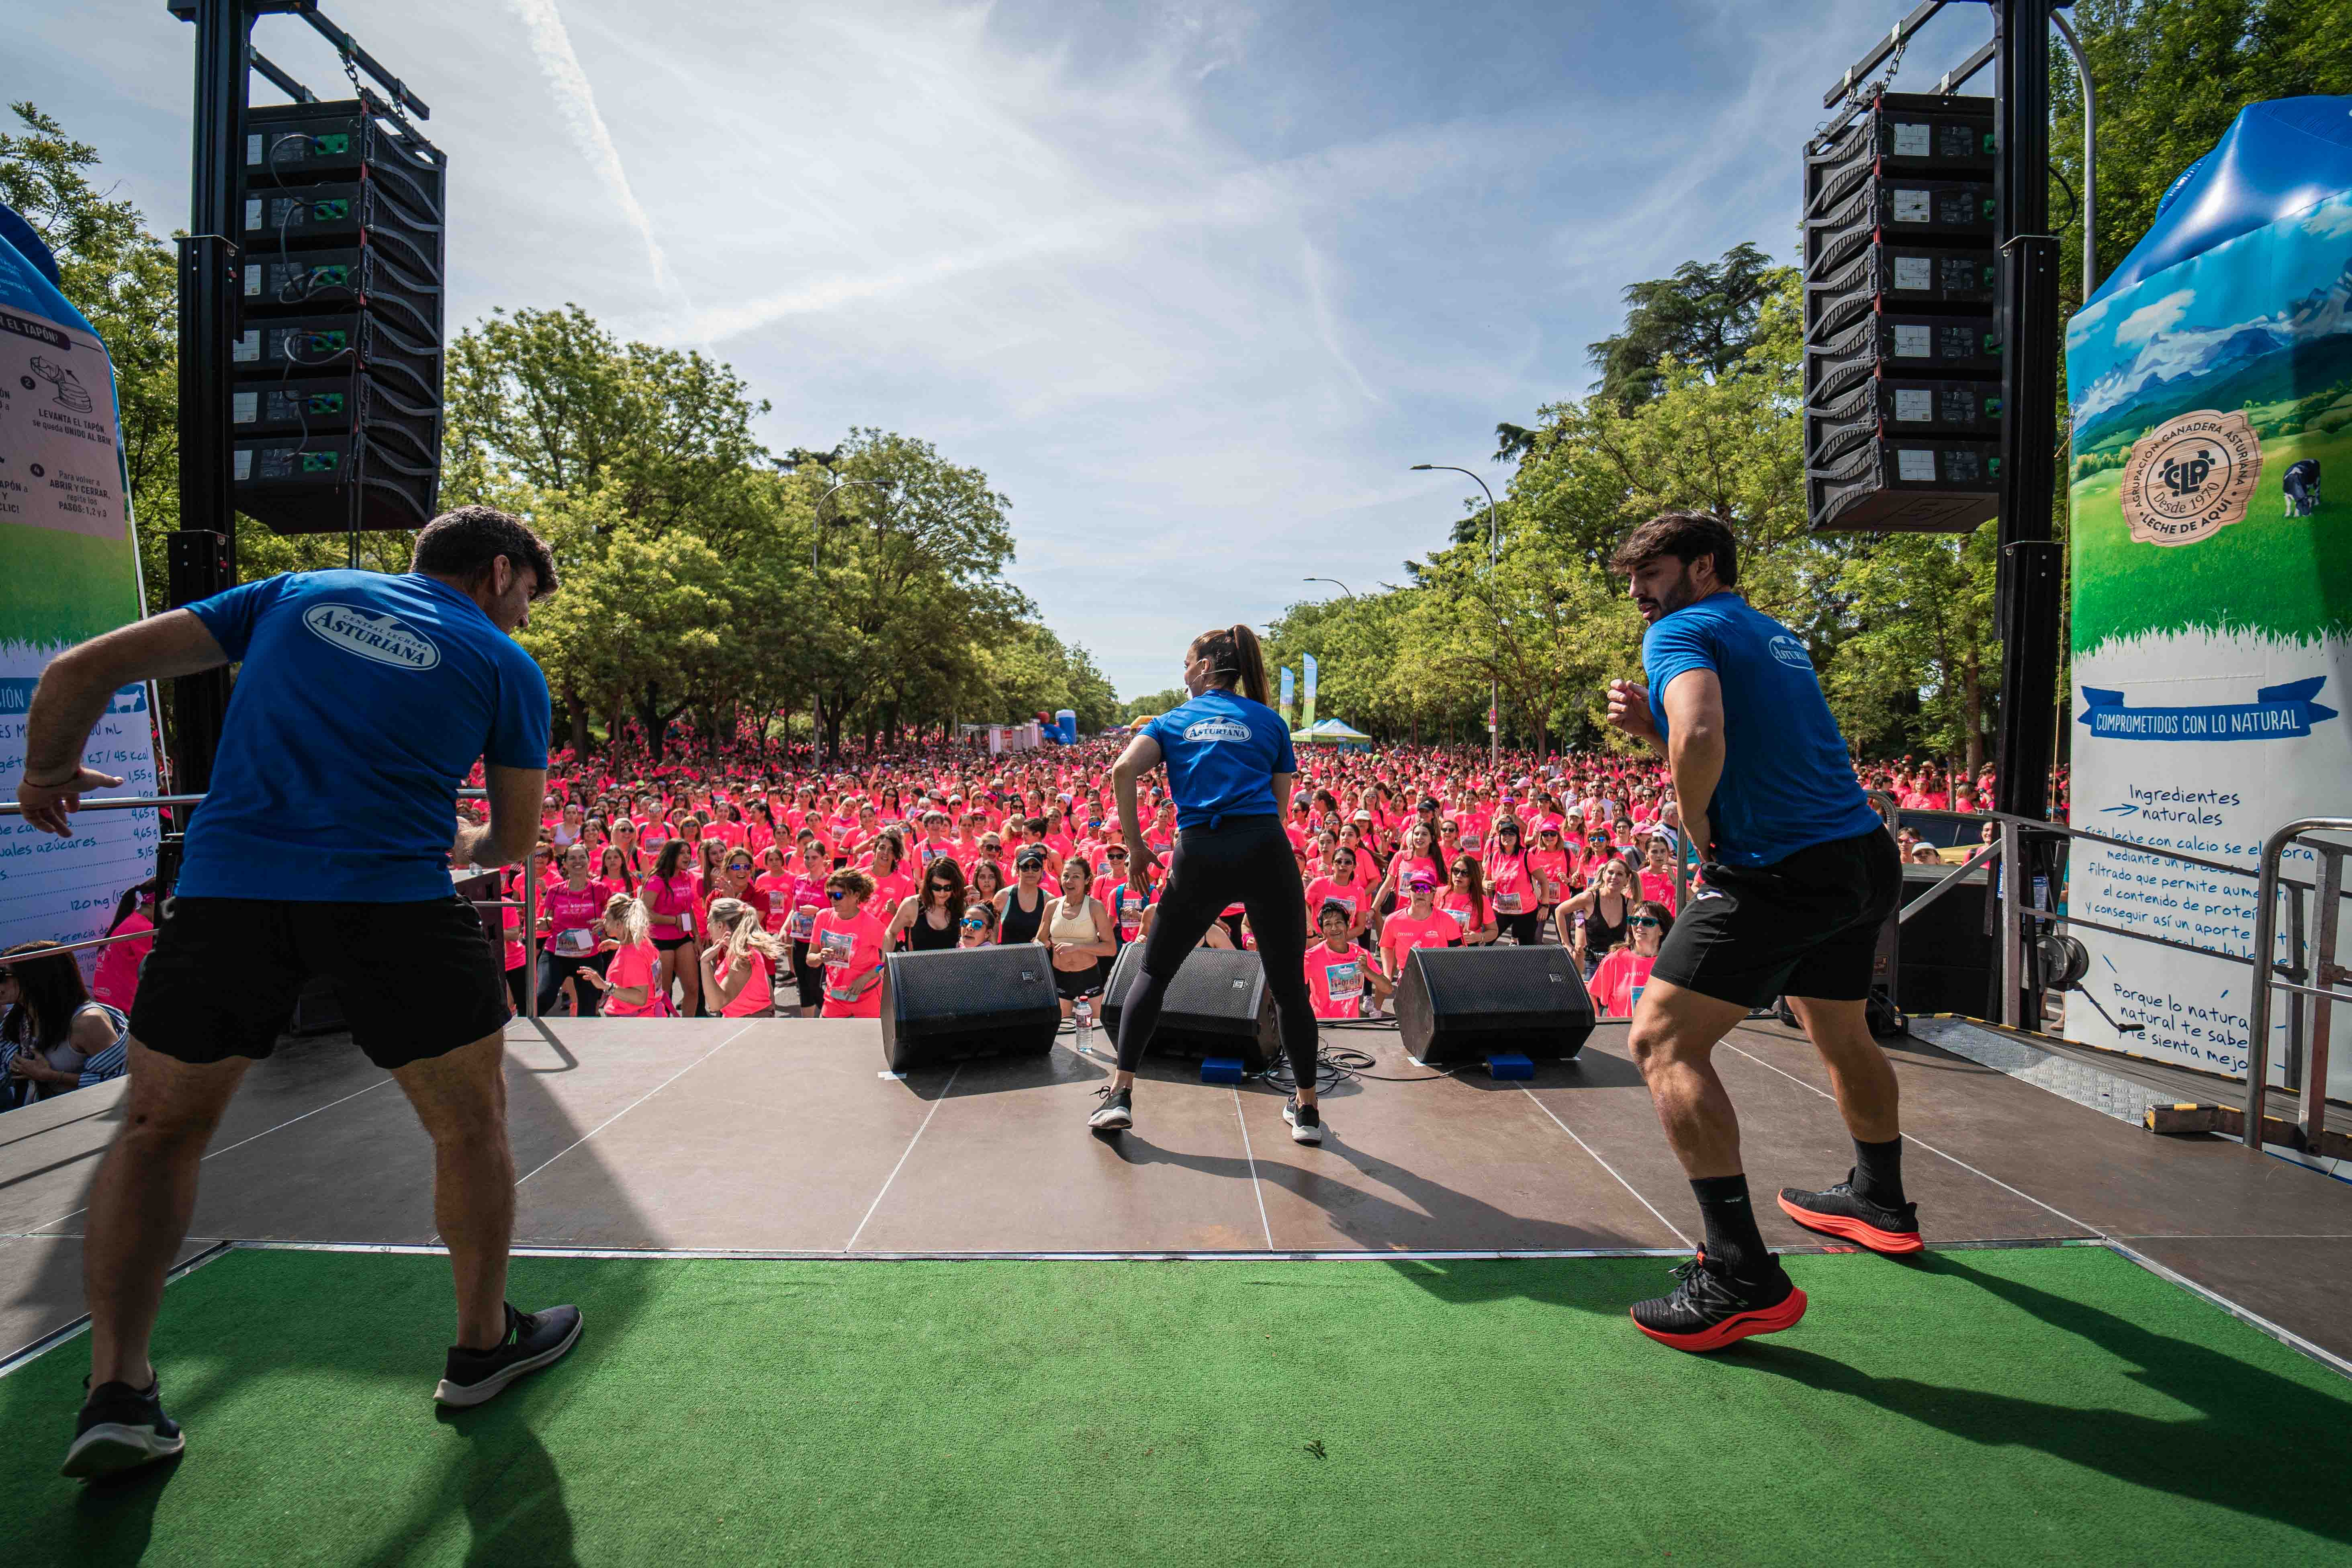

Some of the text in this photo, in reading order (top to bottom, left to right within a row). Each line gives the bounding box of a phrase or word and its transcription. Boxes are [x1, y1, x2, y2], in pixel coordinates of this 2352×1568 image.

[6, 318, 21, 331] EL
[39, 408, 72, 425] LEVANTA
[73, 418, 82, 427] EL
[32, 419, 112, 446] se queda UNIDO AL BRIK
[2132, 422, 2250, 507] AGRUPACIÓN GANADERA ASTURIANA
[49, 479, 73, 491] ABRIR
[74, 484, 79, 492] Y
[59, 470, 74, 480] Para
[76, 475, 94, 485] volver
[67, 494, 97, 505] repite los
[2153, 482, 2220, 513] Desde 1970
[102, 509, 107, 517] 3
[2141, 498, 2232, 534] LECHE DE AQUÍ
[311, 610, 425, 665] ASTURIANA
[343, 614, 428, 651] CENTRAL LECHERA
[1189, 727, 1245, 738] ASTURIANA
[2096, 709, 2300, 734] COMPROMETIDOS CON LO NATURAL
[114, 751, 127, 762] 45
[2129, 784, 2240, 806] Ingredientes
[2142, 807, 2223, 826] naturales
[2148, 837, 2172, 848] con
[2177, 835, 2219, 852] calcio
[2224, 843, 2242, 854] se
[2107, 848, 2160, 865] mediante
[2164, 858, 2178, 868] un
[2088, 862, 2131, 881] filtrado
[2136, 874, 2157, 885] que
[2162, 878, 2217, 893] permite
[71, 899, 91, 911] 120
[94, 897, 109, 909] mg
[2103, 883, 2112, 897] el
[2116, 890, 2178, 907] contenido
[2183, 896, 2199, 910] de
[2094, 905, 2148, 924] conseguir
[2154, 914, 2172, 927] así
[2175, 920, 2189, 930] un
[2195, 923, 2250, 939] aporte
[2113, 983, 2250, 1030] Porque lo natura
[2121, 1006, 2248, 1049] natural te sabe
[2152, 1034, 2200, 1058] sienta
[2207, 1050, 2249, 1072] mejo
